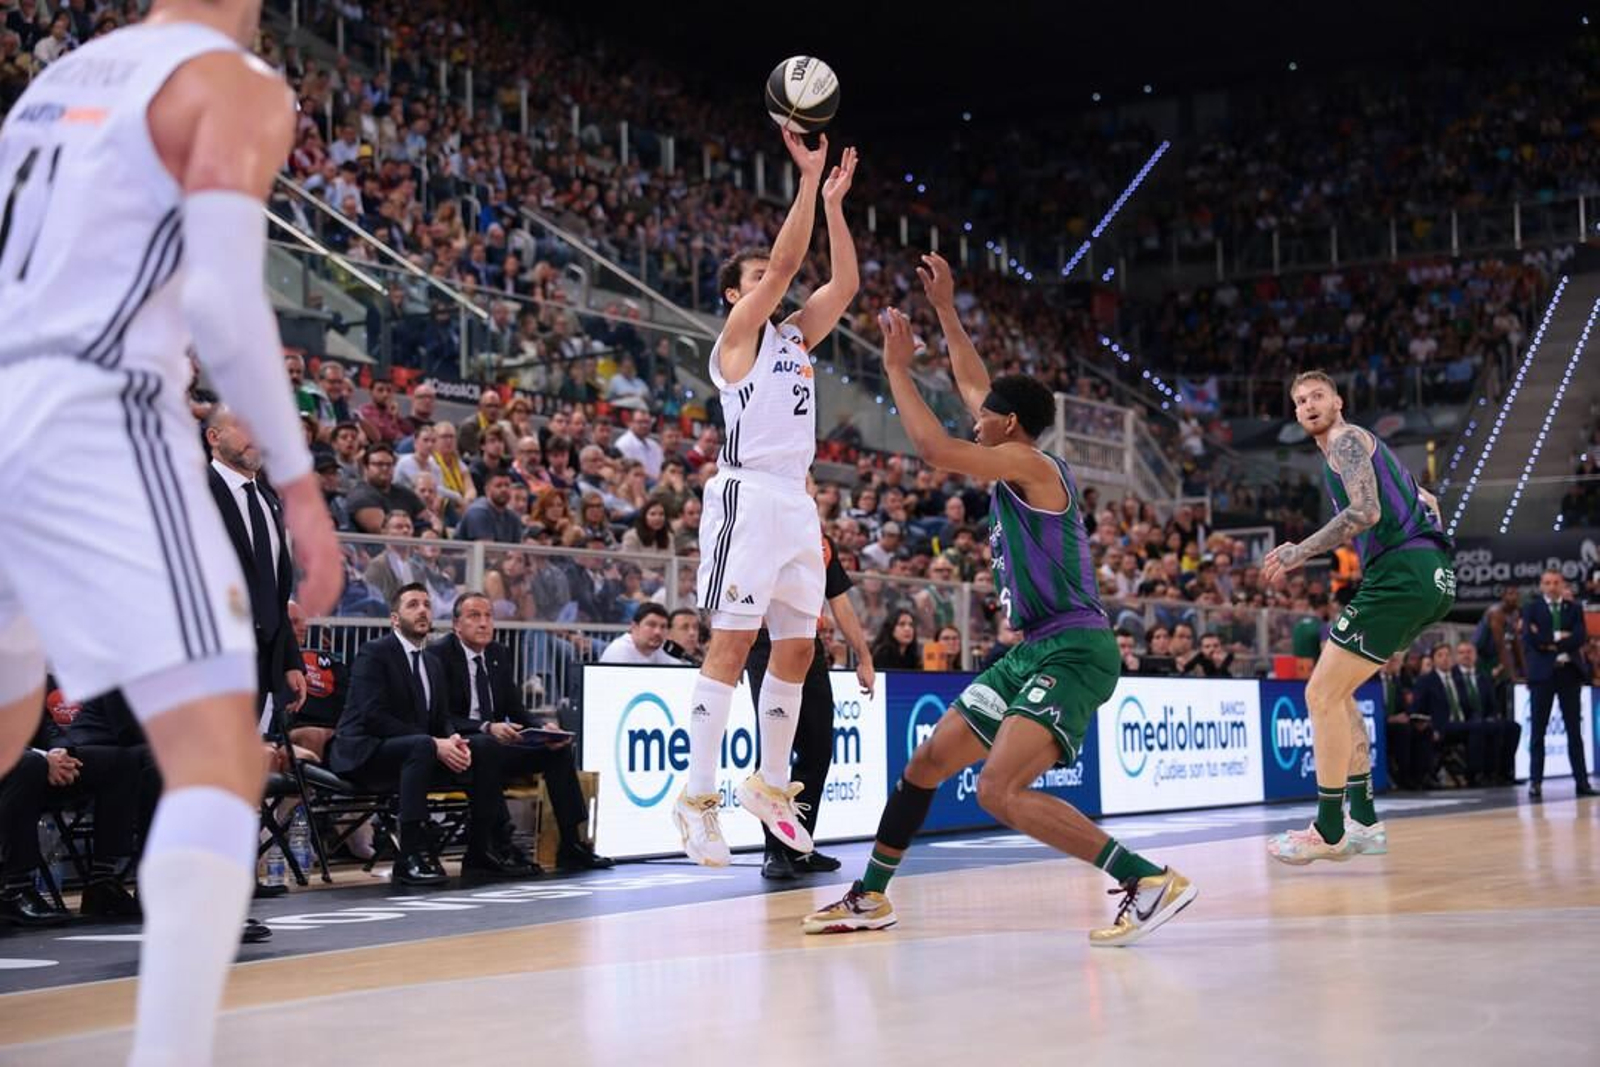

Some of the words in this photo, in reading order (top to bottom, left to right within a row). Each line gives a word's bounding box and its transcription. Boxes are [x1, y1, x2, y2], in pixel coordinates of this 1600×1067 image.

[1453, 561, 1512, 585] opa
[833, 700, 862, 720] NCO
[1121, 705, 1248, 753] mediolanum
